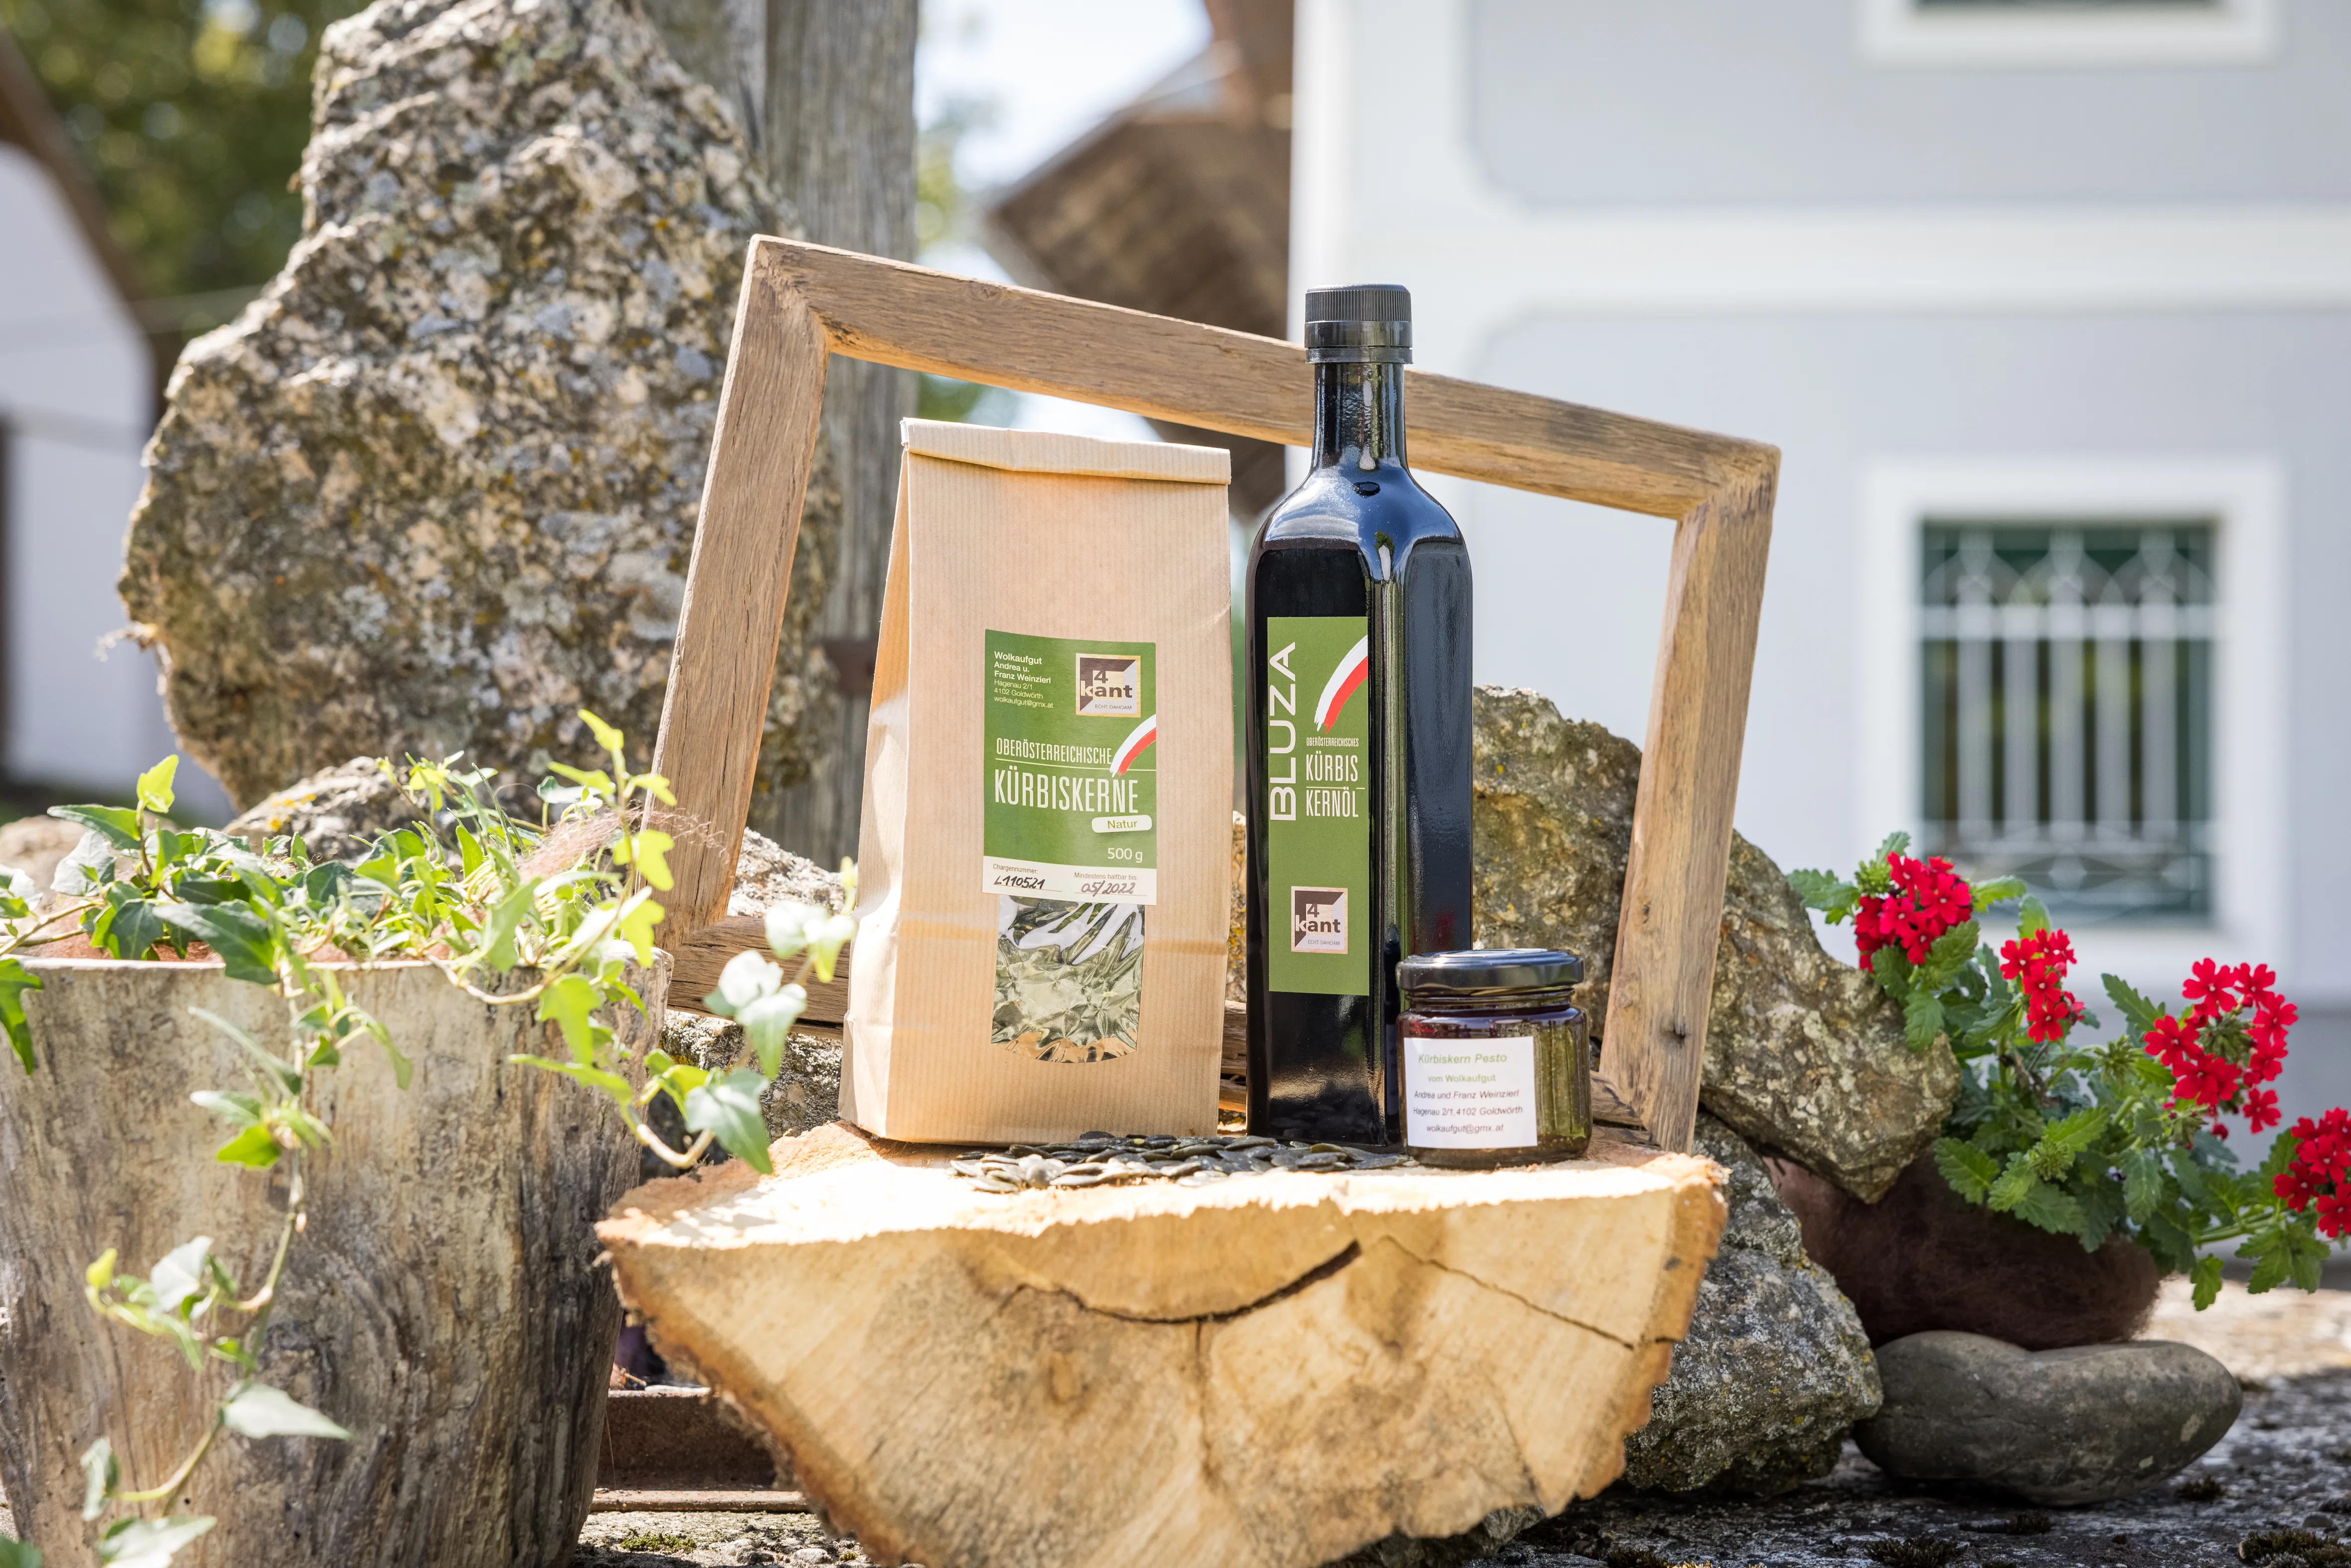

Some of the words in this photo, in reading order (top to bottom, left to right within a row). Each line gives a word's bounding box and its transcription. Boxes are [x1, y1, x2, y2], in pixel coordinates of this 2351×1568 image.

[994, 651, 1042, 665] Wolkaufgut
[994, 661, 1021, 671] Andrea
[994, 670, 1015, 679] Franz
[1017, 673, 1051, 684] Weinzierl
[994, 679, 1021, 688] Hagenau
[1093, 670, 1109, 684] 4
[1011, 690, 1043, 699] Goldwörth
[1080, 681, 1133, 698] kant
[994, 696, 1053, 708] wolkaufgut@gmx.at
[1270, 641, 1296, 821] BLUZA
[1306, 736, 1359, 747] OBERÖSTERREICHISCHES
[996, 737, 1112, 764] OBERÖSTERREICHISCHE
[1306, 750, 1358, 782] KÜRBIS
[995, 765, 1138, 813] KÜRBISKERNE
[1306, 787, 1359, 818] KERNÖL
[1107, 820, 1138, 829] Natur
[1108, 848, 1132, 860] 500
[1135, 851, 1143, 863] g
[993, 863, 1039, 874] Chargennummer:
[1081, 880, 1136, 897] 05/2022
[1307, 903, 1320, 918] 4
[1295, 915, 1341, 934] kant
[1418, 1054, 1471, 1064] Kürbiskern
[1475, 1053, 1507, 1063] Pesto
[1445, 1074, 1496, 1083] Wolkaufgut
[1414, 1090, 1435, 1099] Andrea
[1480, 1089, 1519, 1098] Weinzierl
[1413, 1107, 1440, 1117] Hagenau
[1480, 1106, 1523, 1115] Goldwörth
